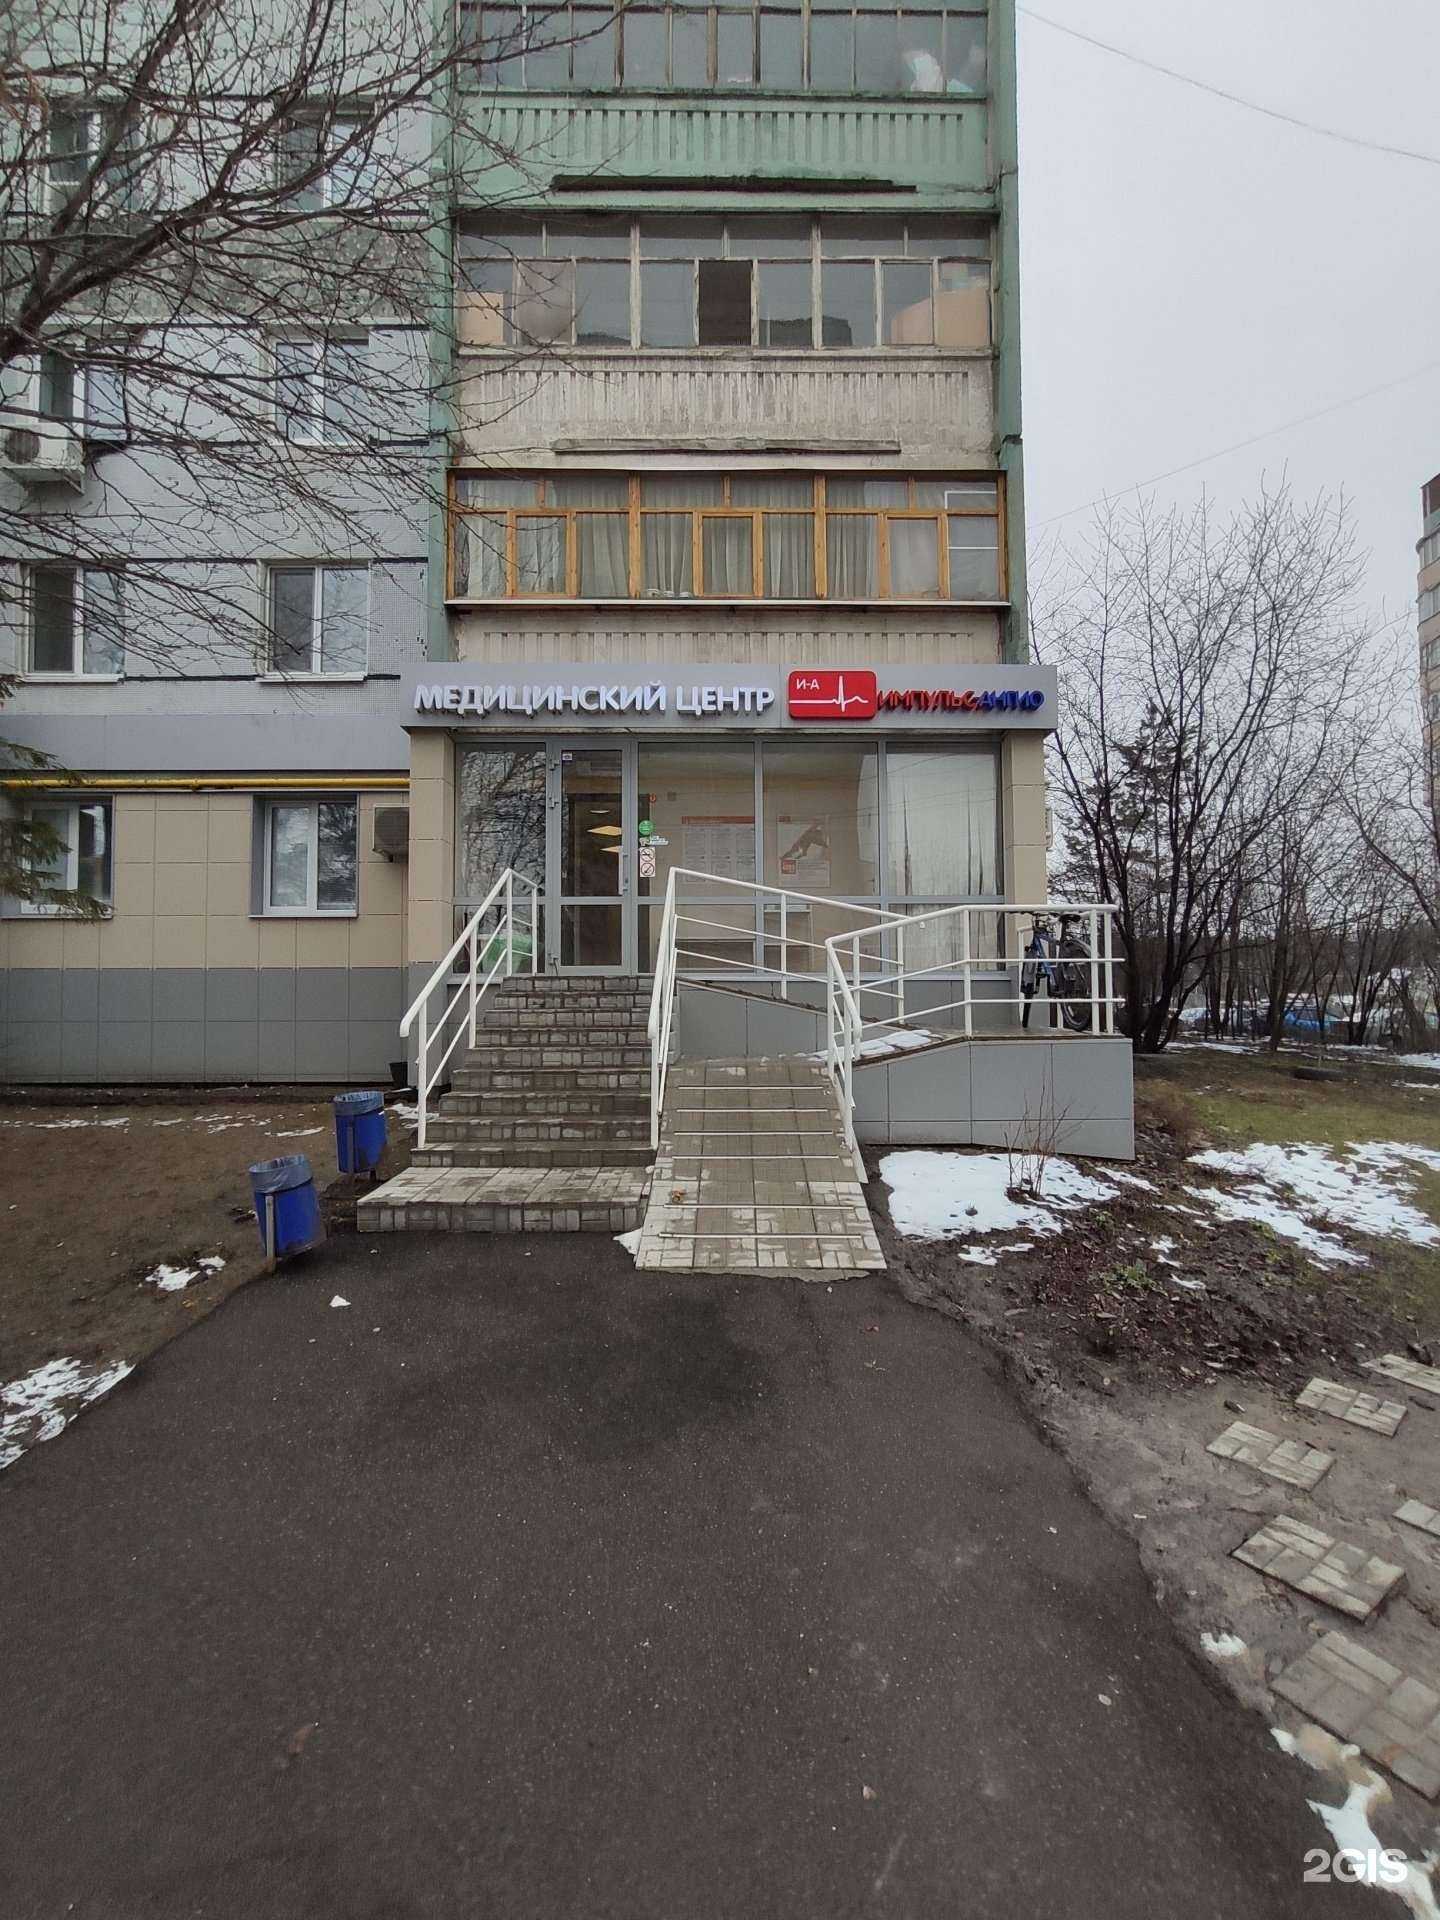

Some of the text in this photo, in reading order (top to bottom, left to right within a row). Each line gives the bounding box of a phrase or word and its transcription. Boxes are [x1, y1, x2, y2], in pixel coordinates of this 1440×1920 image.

[796, 678, 820, 690] И-А
[414, 680, 774, 715] МЕДИЦИНСКИЙ ЦЕНТР
